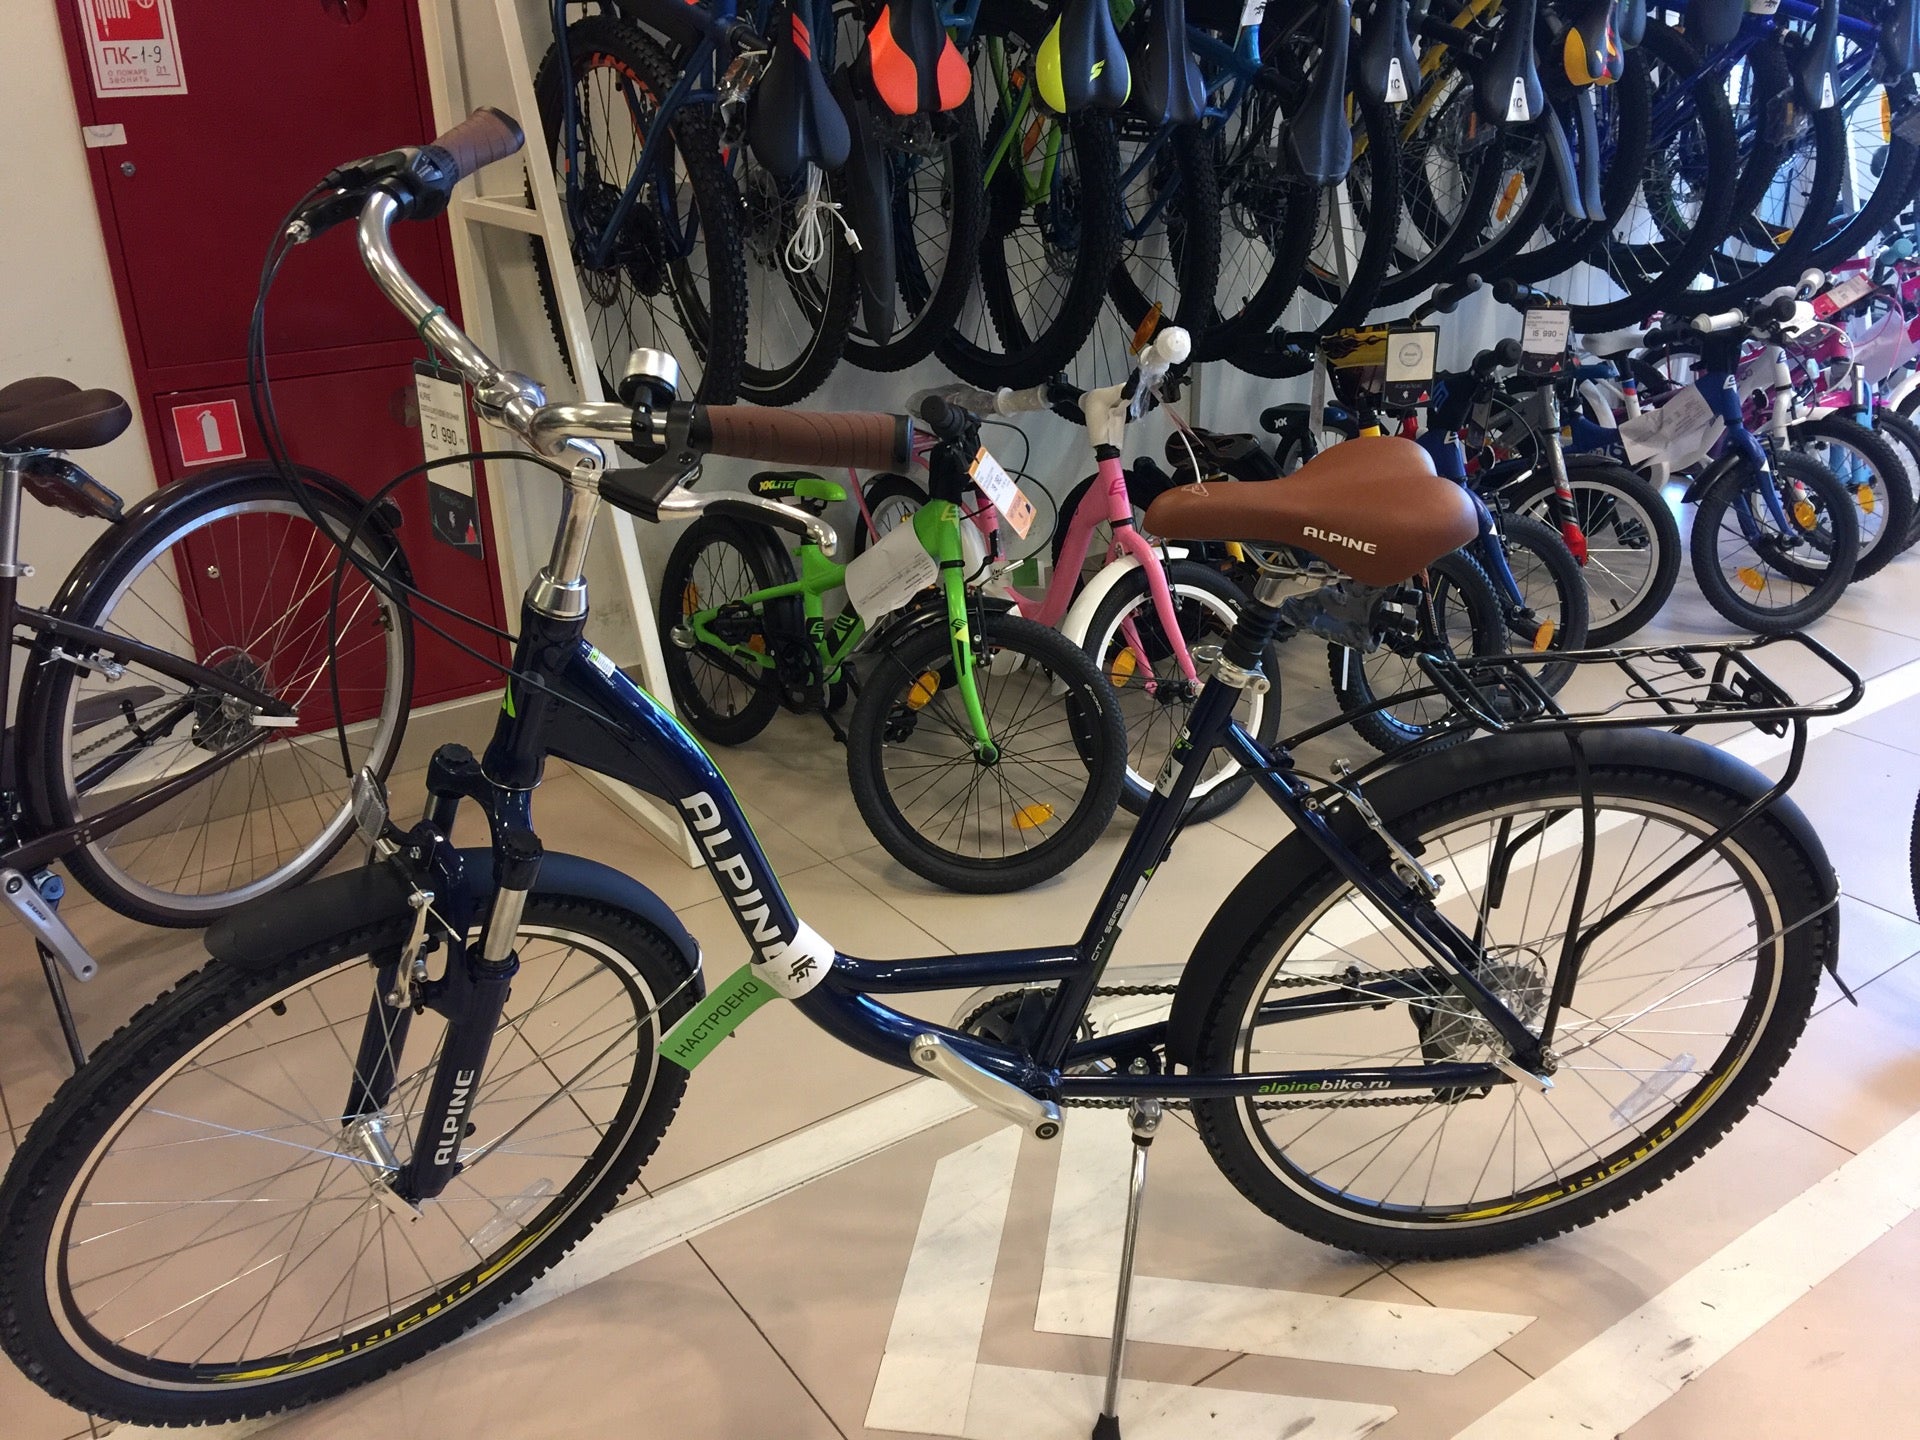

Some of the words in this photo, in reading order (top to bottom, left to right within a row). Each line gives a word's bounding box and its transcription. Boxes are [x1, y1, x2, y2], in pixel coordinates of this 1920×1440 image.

[108, 75, 150, 84] ЗВОНИТЬ
[116, 67, 148, 76] ПОЖАРЕ
[430, 423, 439, 440] 21
[441, 426, 458, 446] 990
[1303, 526, 1377, 555] ALPINE
[1091, 936, 1106, 961] CITY
[1104, 893, 1128, 934] SERIES
[674, 981, 759, 1058] НАСТРОЕНО
[1258, 1078, 1391, 1094] alpinebike.ru
[434, 1069, 475, 1166] ALPINE
